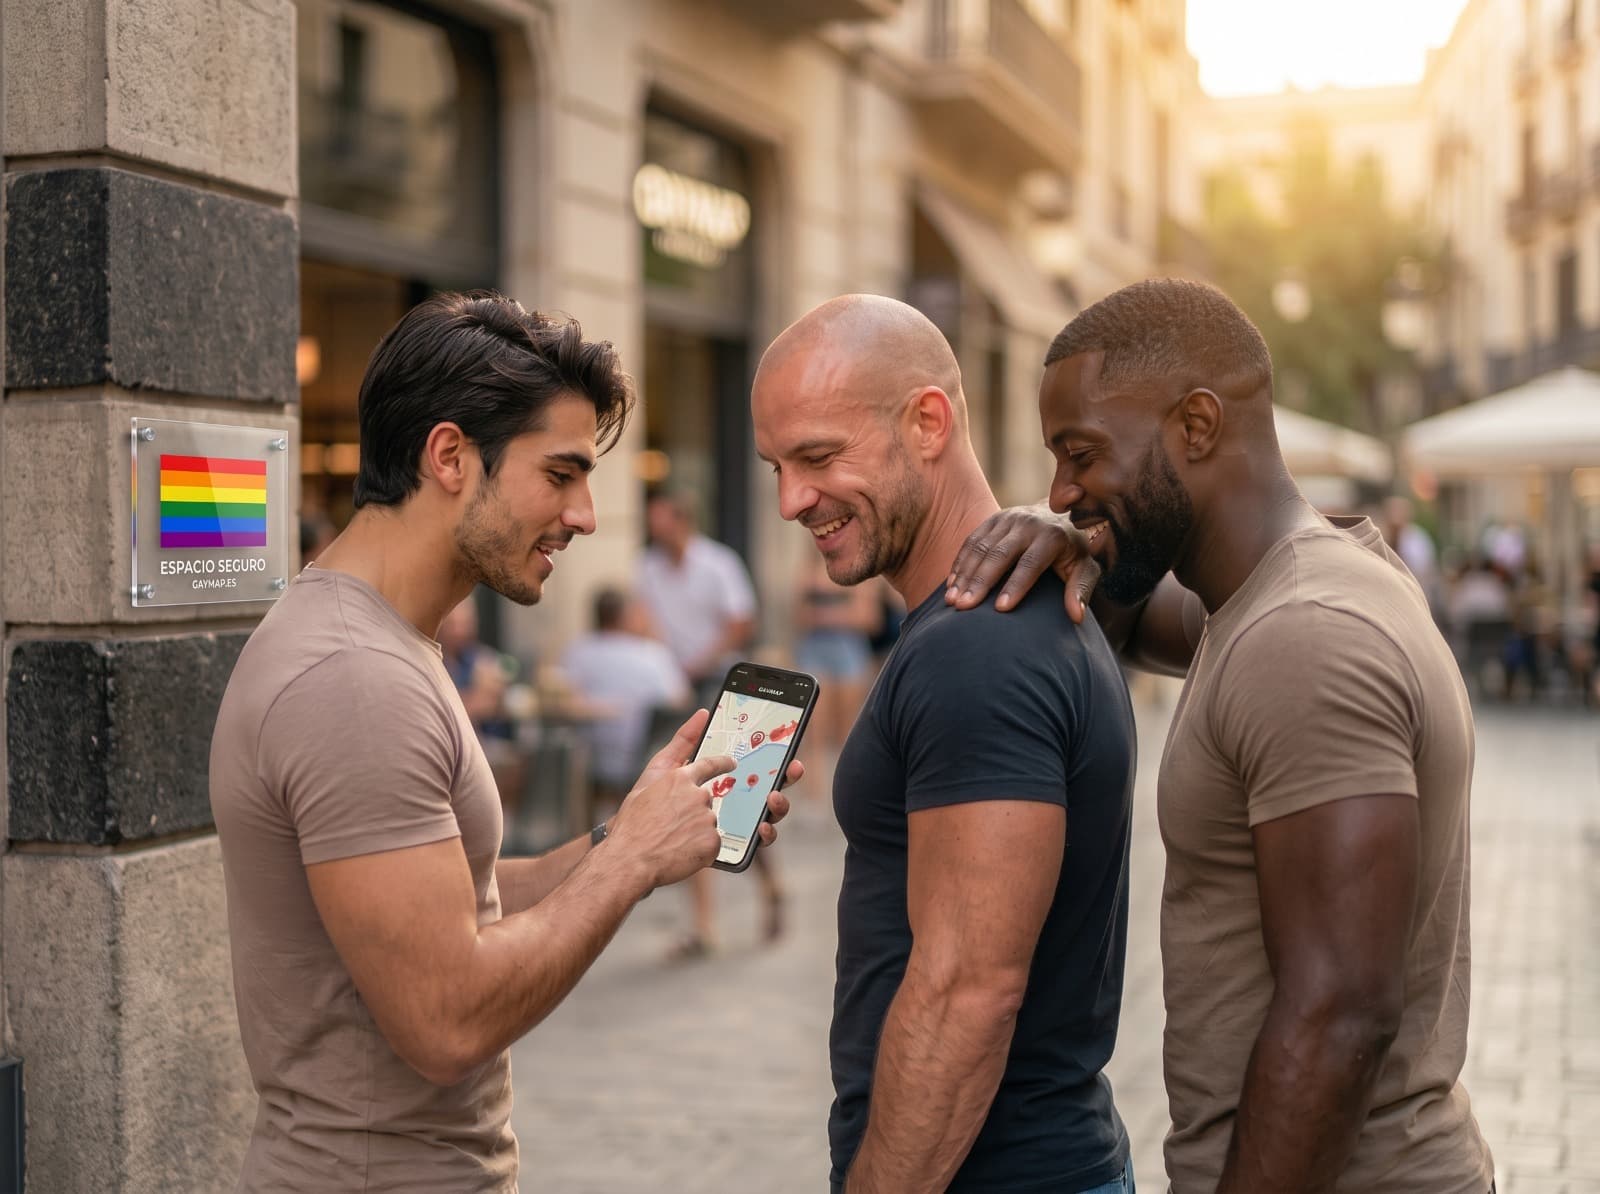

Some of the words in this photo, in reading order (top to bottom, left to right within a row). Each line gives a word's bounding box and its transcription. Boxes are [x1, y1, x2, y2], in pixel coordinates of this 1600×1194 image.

[160, 560, 215, 575] ESPACIO
[218, 558, 266, 573] SEGURO
[192, 578, 237, 589] GAYMAP.ES
